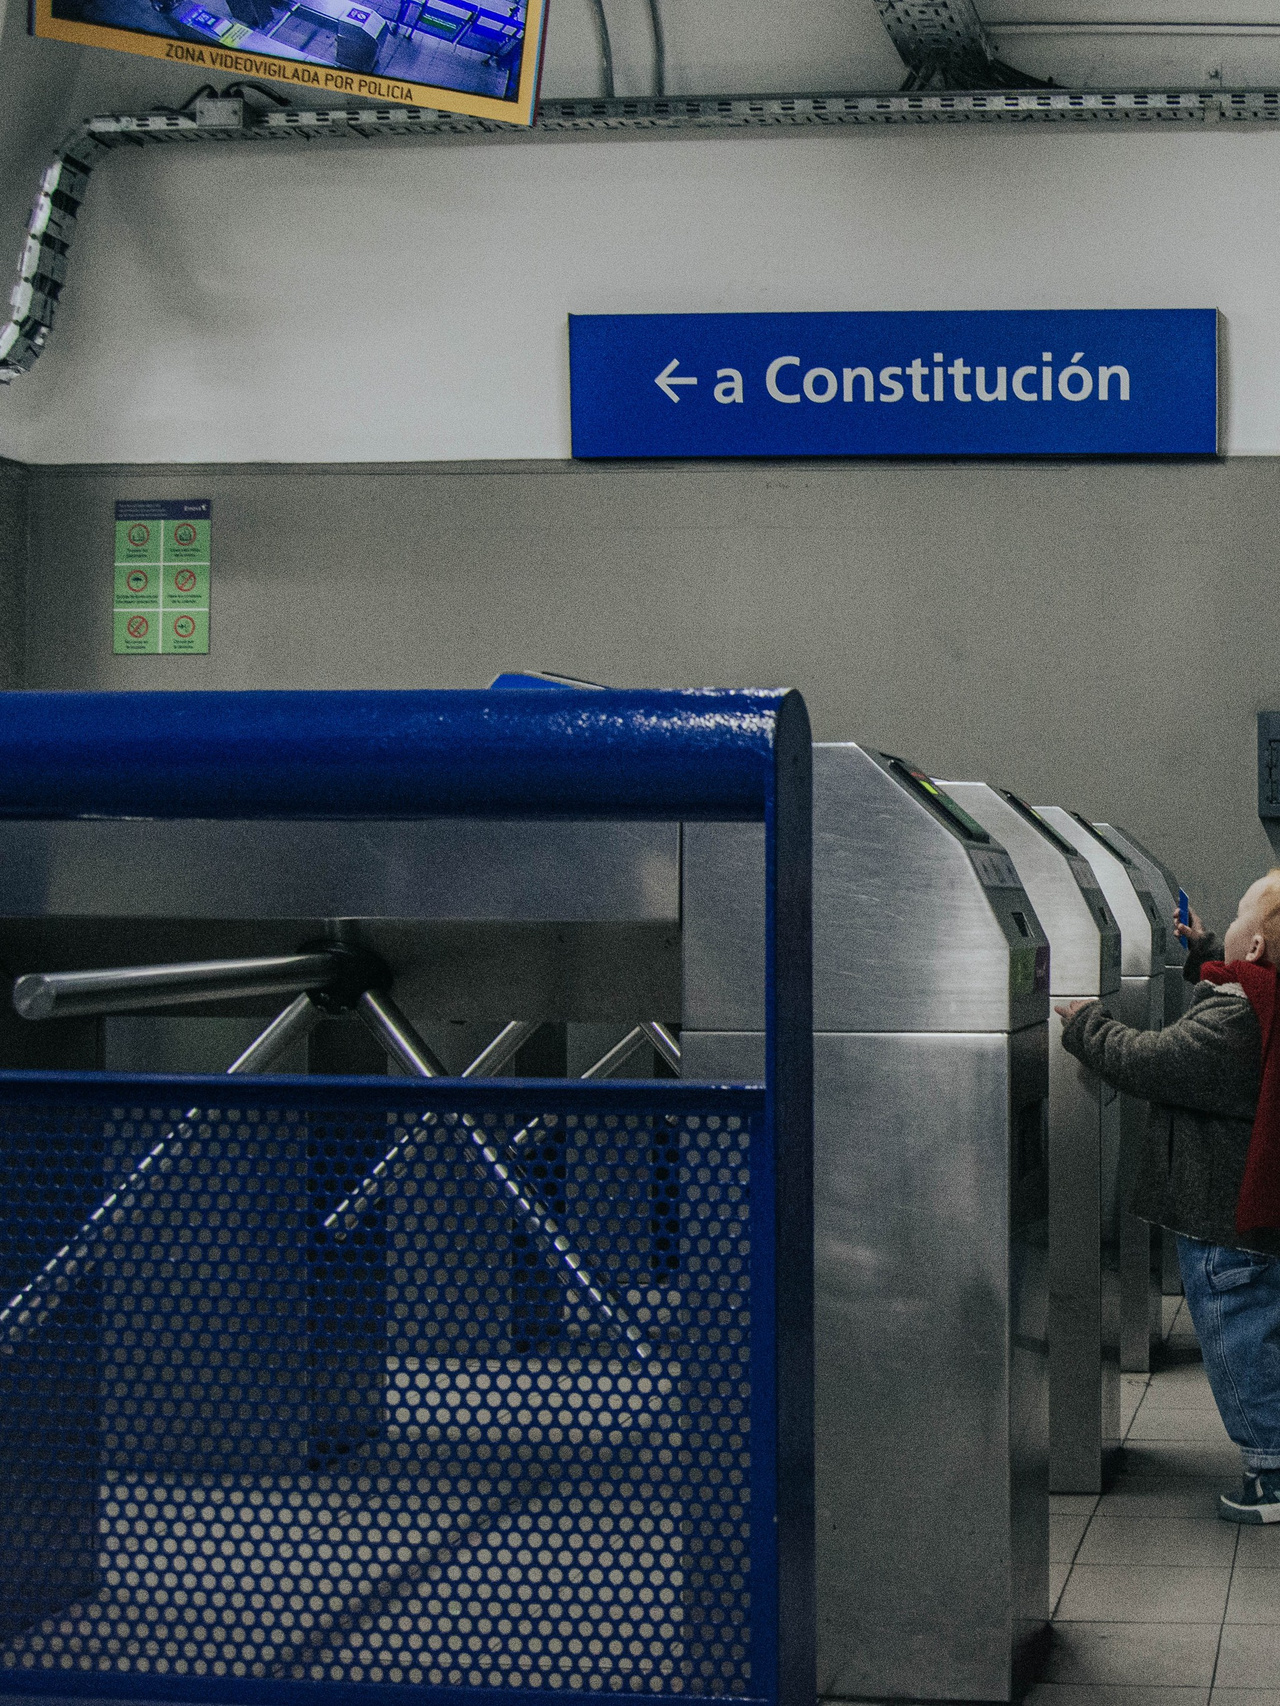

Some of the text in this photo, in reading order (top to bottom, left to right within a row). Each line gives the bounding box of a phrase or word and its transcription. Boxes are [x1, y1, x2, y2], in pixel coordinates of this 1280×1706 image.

[165, 43, 414, 102] ZONA VIDEOVIGILADA POR POLICIA
[713, 351, 1131, 405] a Constitución
